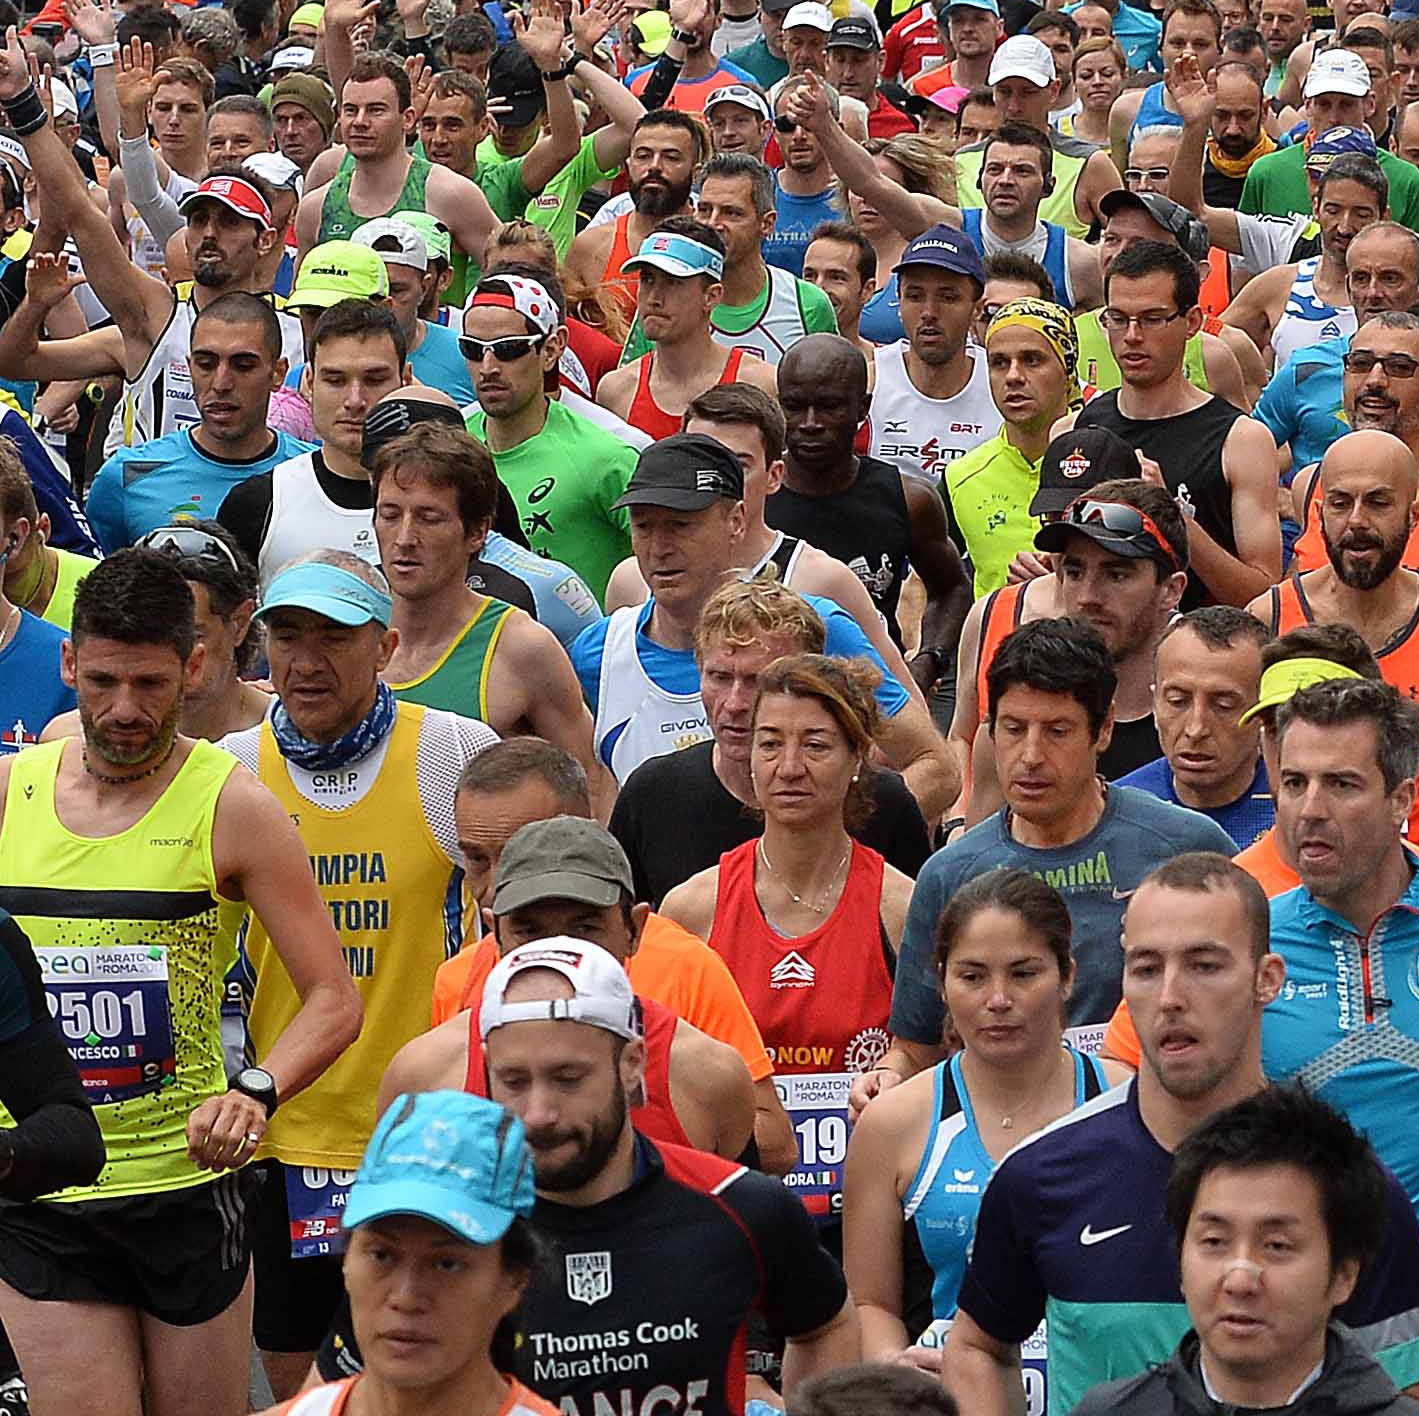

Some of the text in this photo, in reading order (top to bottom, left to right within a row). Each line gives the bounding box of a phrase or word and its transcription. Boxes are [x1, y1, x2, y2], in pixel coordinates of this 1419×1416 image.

[950, 422, 983, 435] BRT
[1047, 851, 1112, 890] MINA
[328, 899, 389, 931] TORI
[944, 1183, 980, 1193] erima
[531, 1322, 700, 1358] Thomas Cook
[534, 1351, 650, 1383] Marathon
